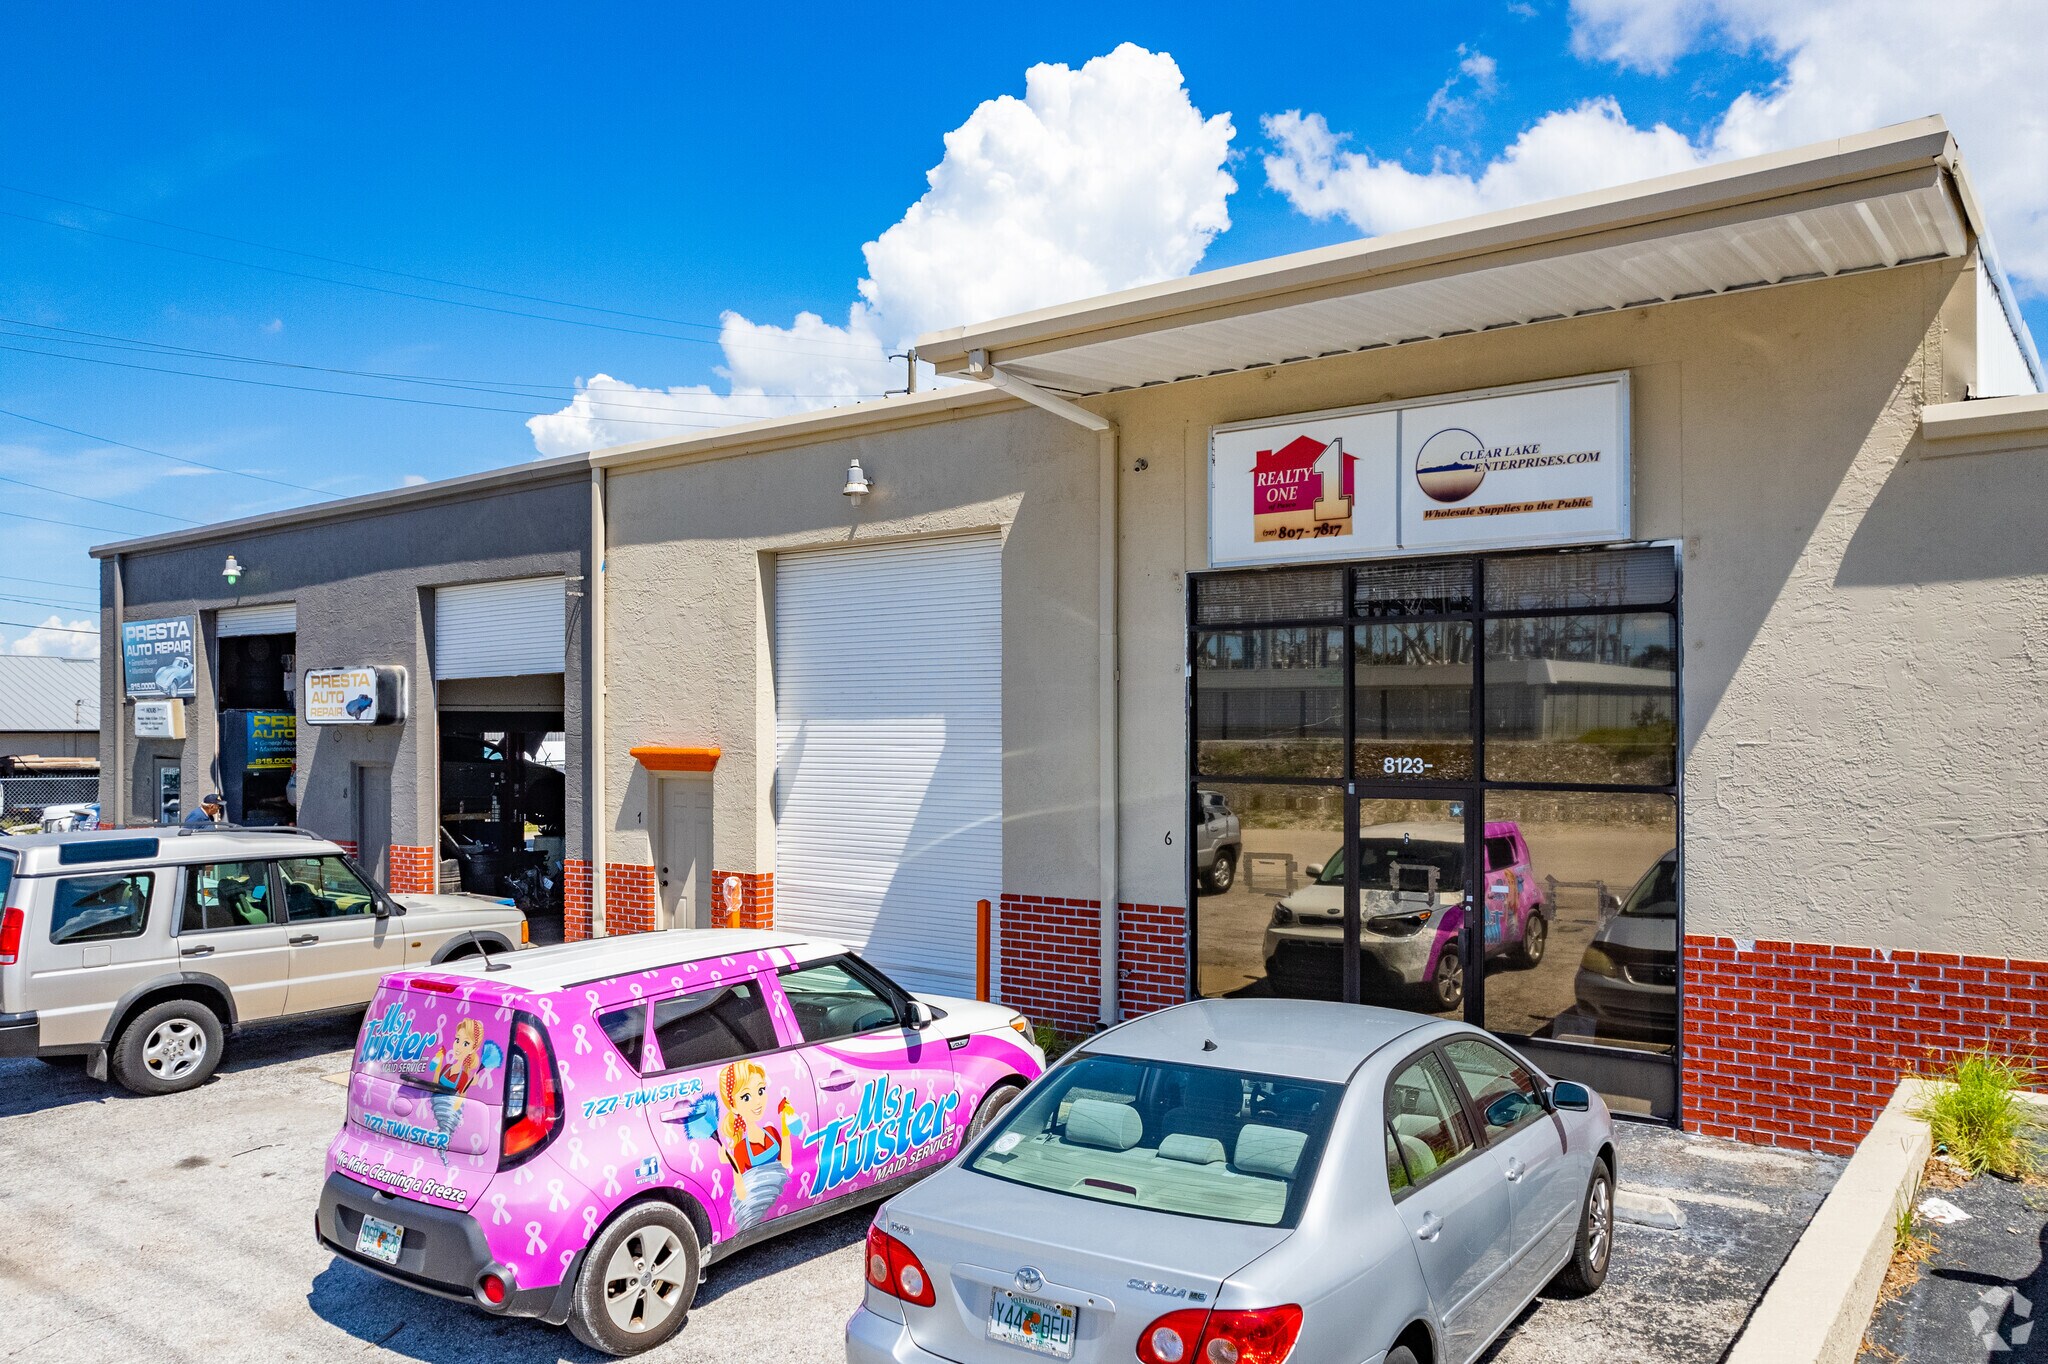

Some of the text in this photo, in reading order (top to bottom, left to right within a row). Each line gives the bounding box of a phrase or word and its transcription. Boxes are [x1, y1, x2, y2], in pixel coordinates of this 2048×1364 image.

[1460, 444, 1540, 460] CLEAR LAKE
[1474, 451, 1600, 473] ENTERPRISES.COM
[1256, 467, 1312, 487] REALTY
[1266, 486, 1298, 503] ONE
[1424, 497, 1592, 519] Wholesale Supplies to the Public
[125, 621, 191, 641] PRESTA
[126, 639, 192, 657] AUTO REPAIR
[310, 673, 371, 689] PRESTA
[311, 691, 345, 705] AUTO
[310, 707, 343, 718] REPAIR
[252, 729, 296, 739] AUTO
[1164, 830, 1172, 846] 6
[1404, 832, 1410, 845] 6
[376, 1002, 406, 1034] Ms
[359, 1018, 437, 1064] Twister
[381, 1062, 427, 1073] MAID SERVICE
[581, 1077, 704, 1120] 727-TWISTER
[845, 1073, 903, 1137] Ms
[363, 1112, 450, 1151] 727-TWISTER
[803, 1088, 961, 1200] Twister
[873, 1133, 955, 1182] MAID SERVICE
[336, 1150, 468, 1204] We Make Cleaning a Breeze
